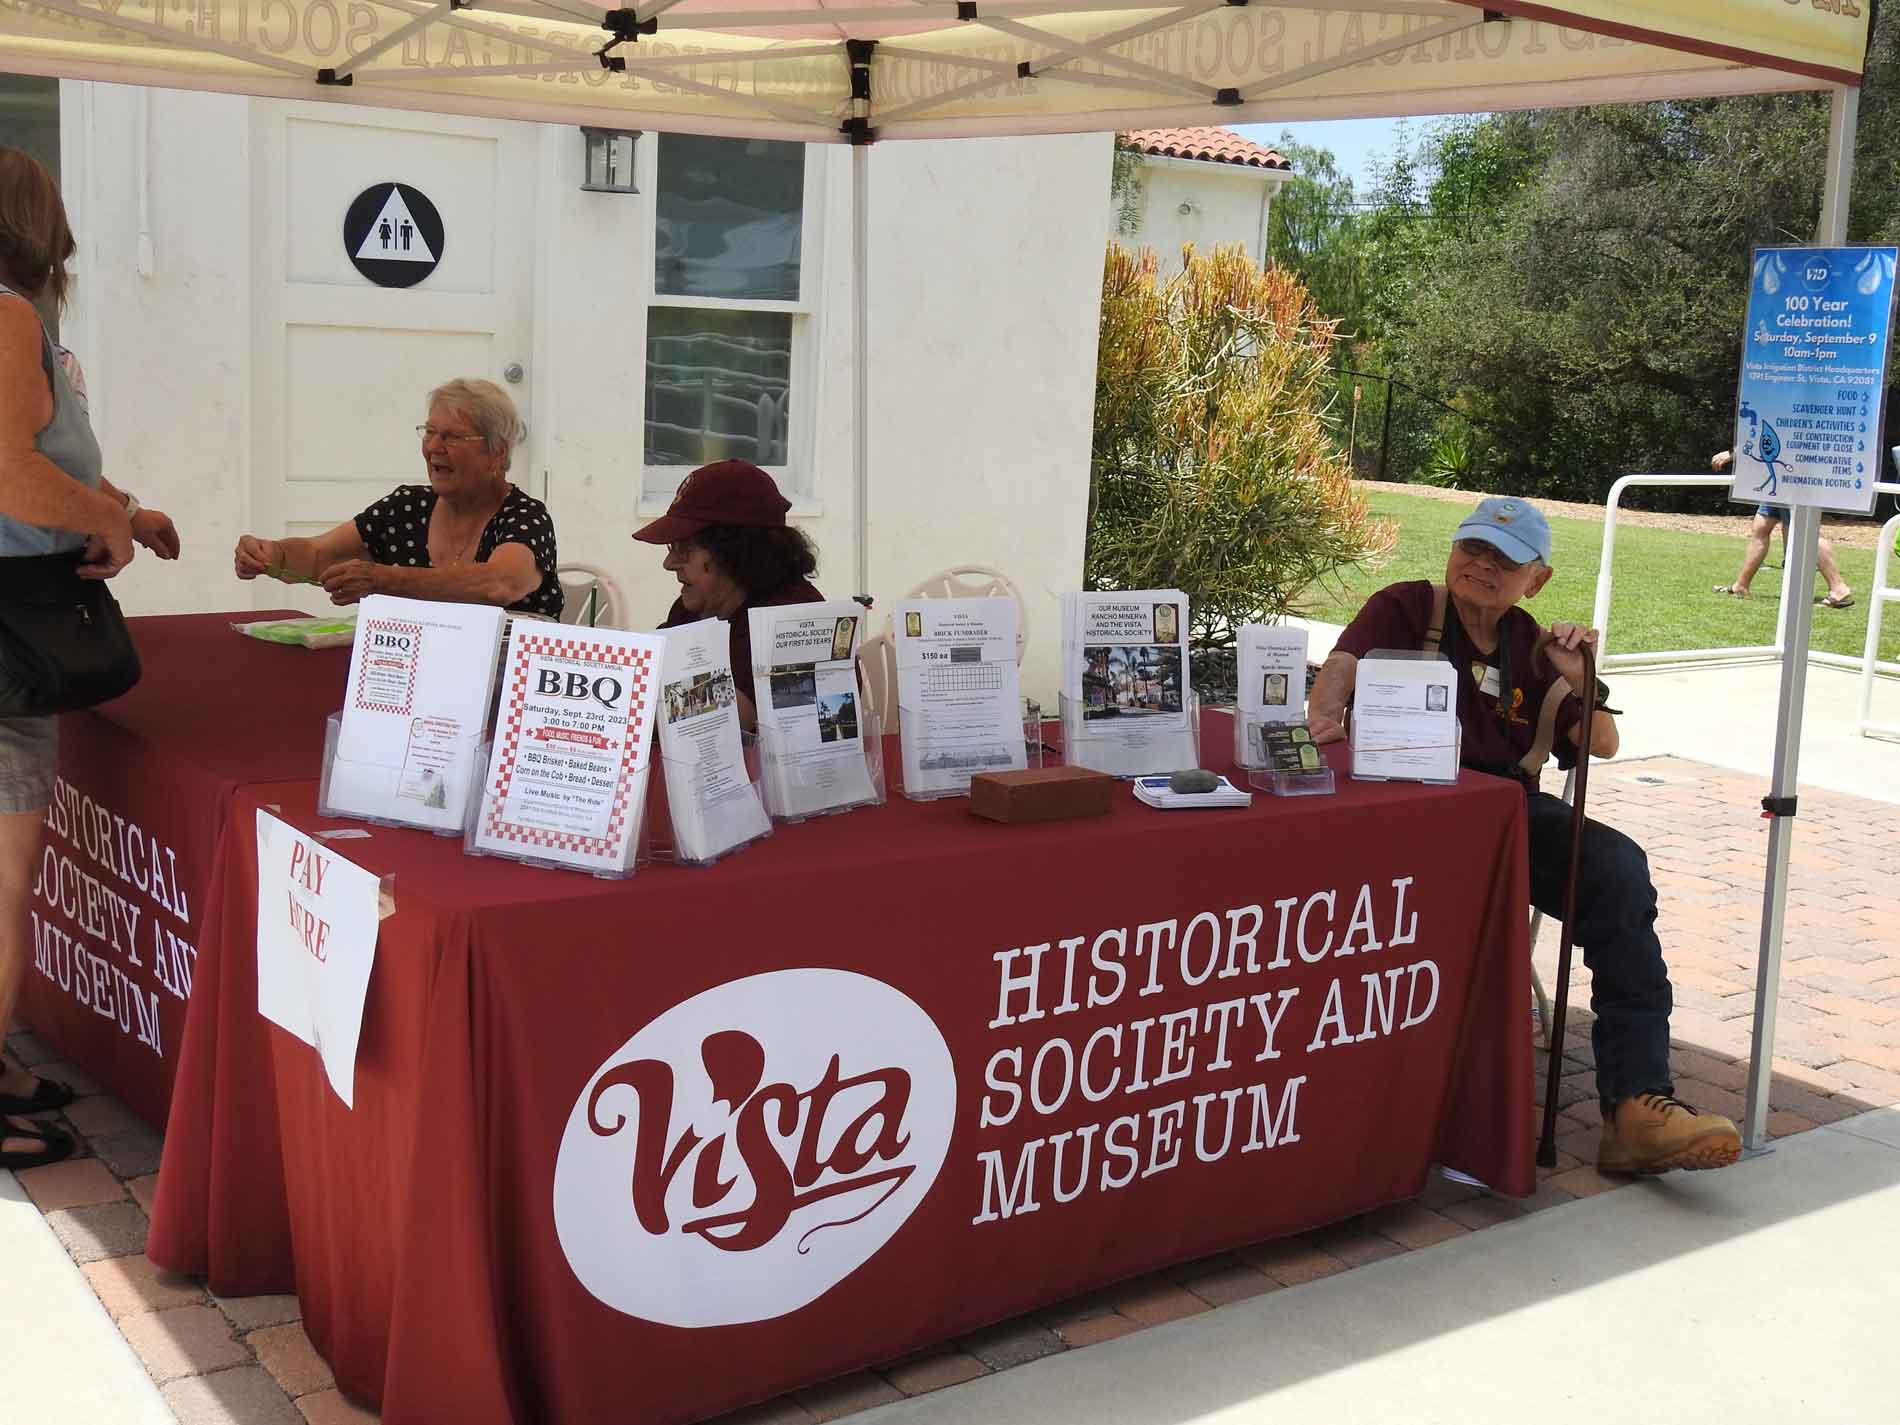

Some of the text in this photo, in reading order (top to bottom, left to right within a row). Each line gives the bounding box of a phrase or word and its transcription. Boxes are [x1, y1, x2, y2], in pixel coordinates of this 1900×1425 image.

[1784, 296, 1849, 312] 100 Year
[1776, 314, 1852, 327] Celebration!
[1754, 330, 1877, 346] Saturday, September 9
[1783, 347, 1837, 361] 10am-1pm
[1837, 390, 1858, 400] FOOD
[1792, 403, 1857, 416] SCAVENGER HUNT
[1815, 420, 1855, 431] ACTIVITIES
[1805, 432, 1854, 443] CONSTRUCTION
[1833, 444, 1853, 452] CLOSE
[1795, 454, 1852, 466] COMMEMORATIVE
[1832, 466, 1852, 476] ITEMS
[1782, 475, 1851, 488] INFORMATION BOOTHS
[776, 628, 833, 639] HISTORICAL SOCIETY
[1086, 629, 1123, 637] HISTORICAL
[374, 633, 411, 652] BBQ
[776, 641, 788, 649] OUR
[788, 639, 804, 648] FIRST
[813, 637, 832, 645] YEARS
[922, 652, 938, 660] $150
[535, 668, 622, 710] BBQ
[523, 703, 627, 725] Saturday, Sept. 23rd, 2023
[543, 716, 605, 732] 3:00 to 7:00 PM
[527, 752, 607, 773] BBQ Brisket Baked Beans
[515, 764, 531, 775] Corn
[531, 768, 539, 776] on
[540, 769, 550, 778] the
[551, 770, 564, 780] Cob
[568, 773, 586, 784] Bread
[524, 786, 539, 796] Live
[44, 775, 190, 924] STORICAL
[289, 839, 331, 897] PAY
[154, 919, 198, 1001] AN
[988, 876, 1418, 1030] HISTORICAL
[32, 910, 163, 1058] MUSEUM
[979, 959, 1440, 1129] SOCIETY AND
[587, 1030, 916, 1255] Vista
[972, 1075, 1307, 1226] MUSEUM
